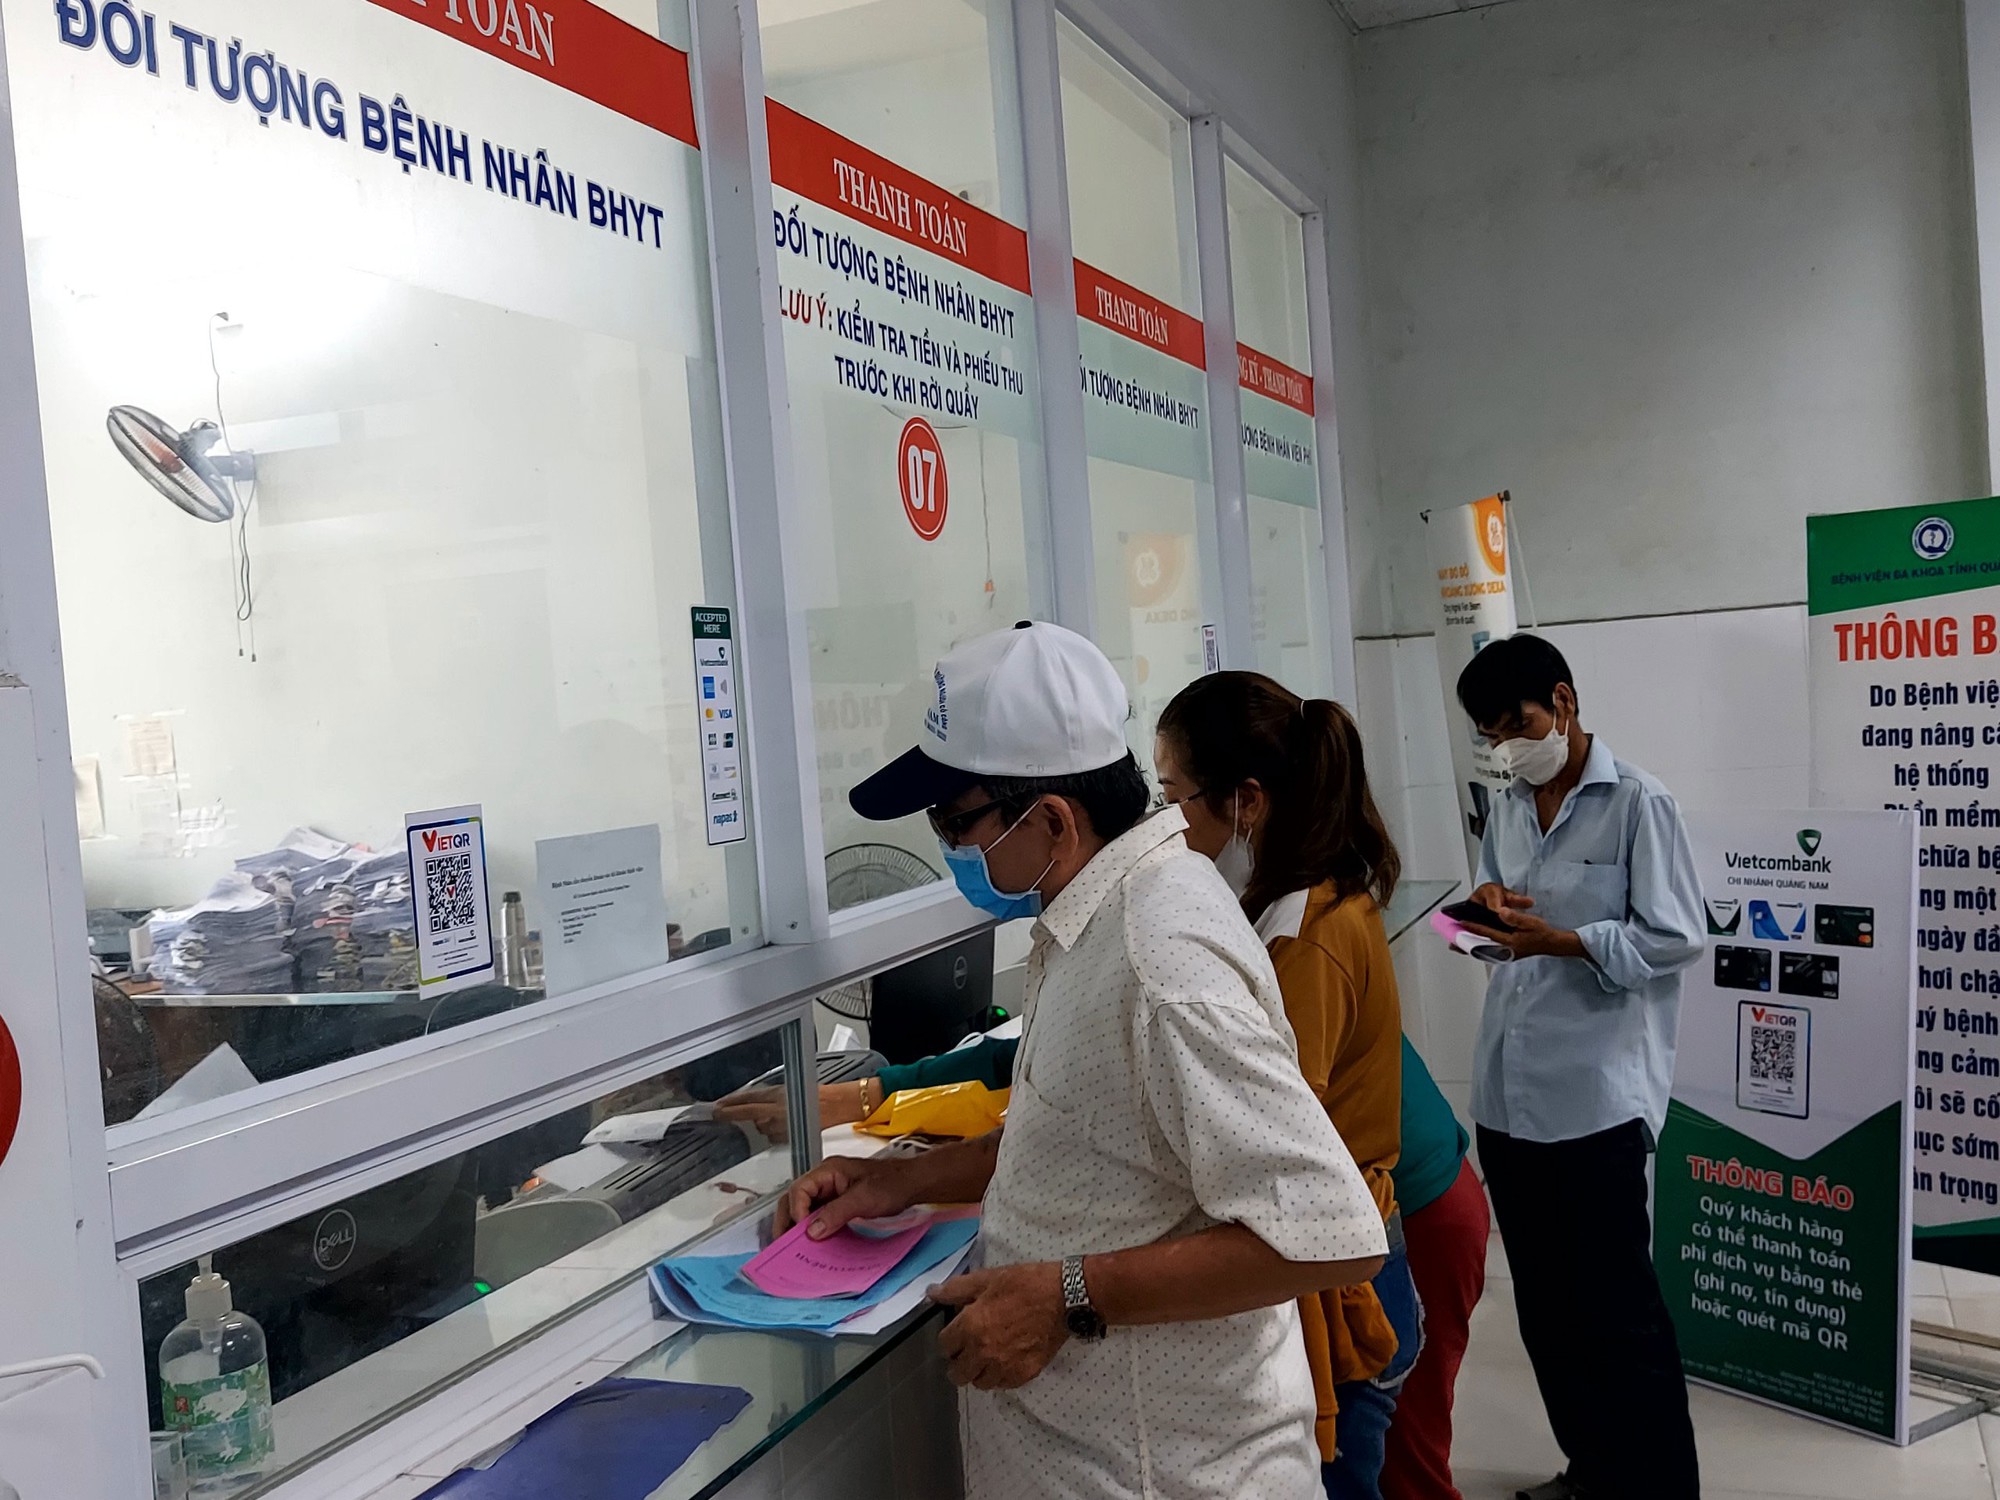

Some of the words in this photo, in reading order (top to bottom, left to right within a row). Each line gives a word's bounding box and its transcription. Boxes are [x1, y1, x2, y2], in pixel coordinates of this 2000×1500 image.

[169, 20, 347, 142] TƯỢNG
[358, 92, 473, 185] BỆNH
[482, 139, 578, 220] NHÂN
[586, 178, 664, 249] BHYT
[833, 158, 912, 232] THANH
[915, 198, 967, 257] TOÁN
[773, 204, 808, 257] ĐỐI
[812, 227, 879, 286] TƯỢNG
[884, 255, 930, 306] BỆNH
[934, 281, 976, 324] NHÂN
[980, 299, 1014, 338] BHYT
[1095, 285, 1138, 332] THANH
[1139, 306, 1168, 346] TOÁN
[779, 285, 812, 323] LƯU
[837, 299, 875, 347] KIỂM
[878, 323, 908, 357] TRA
[944, 340, 961, 374] VÀ
[964, 350, 998, 387] PHIẾU
[1001, 366, 1023, 395] THU
[835, 354, 888, 397] TRƯỚC
[892, 373, 916, 404] KHI
[920, 376, 942, 411] RỜI
[1262, 366, 1286, 397] THANH
[1089, 369, 1124, 405] TƯỢNG
[1126, 378, 1151, 415] BỆNH
[1153, 390, 1176, 422] NHÂN
[1179, 402, 1198, 428] BHYT
[907, 444, 938, 513] 07
[1911, 566, 1945, 577] KHOA
[695, 612, 728, 623] ACCEPTED
[703, 624, 721, 634] HERE
[1834, 613, 1958, 662] THÔNG
[1870, 685, 1896, 707] Do
[1904, 682, 1958, 710] Bệnh
[718, 709, 733, 719] VISA
[1862, 725, 1913, 749] đang
[1921, 722, 1974, 748] nâng
[1895, 763, 1920, 791] hệ
[1927, 759, 1989, 789] thống
[1725, 852, 1831, 873] Vietcombank
[1919, 844, 1970, 868] chữa
[1727, 876, 1741, 885] CHI
[1809, 881, 1829, 890] NAM
[1954, 886, 1997, 915] một
[1917, 925, 1966, 952] ngày
[1944, 1008, 1998, 1037] bệnh
[1952, 1048, 1999, 1077] cảm
[1940, 1091, 1965, 1114] sẽ
[1952, 1133, 1999, 1161] sớm
[1687, 1155, 1783, 1197] THÔNG
[1791, 1175, 1854, 1211] BÁO
[1940, 1171, 1998, 1205] trọng
[1700, 1196, 1734, 1221] Quý
[1741, 1204, 1792, 1231] khách
[1800, 1216, 1843, 1246] hàng
[319, 1228, 353, 1253] DELL
[1692, 1221, 1711, 1238] có
[1752, 1233, 1802, 1260] thanh
[1810, 1247, 1850, 1272] toán
[1681, 1243, 1706, 1262] phí
[1712, 1249, 1746, 1273] dịch
[1753, 1262, 1774, 1282] vụ
[1694, 1268, 1725, 1291] (ghi
[1764, 1286, 1788, 1309] tín
[1794, 1296, 1845, 1326] dụng)
[1691, 1292, 1731, 1319] hoặc
[1737, 1308, 1776, 1333] quét
[1782, 1320, 1810, 1341] mã
[1817, 1327, 1848, 1351] QR
